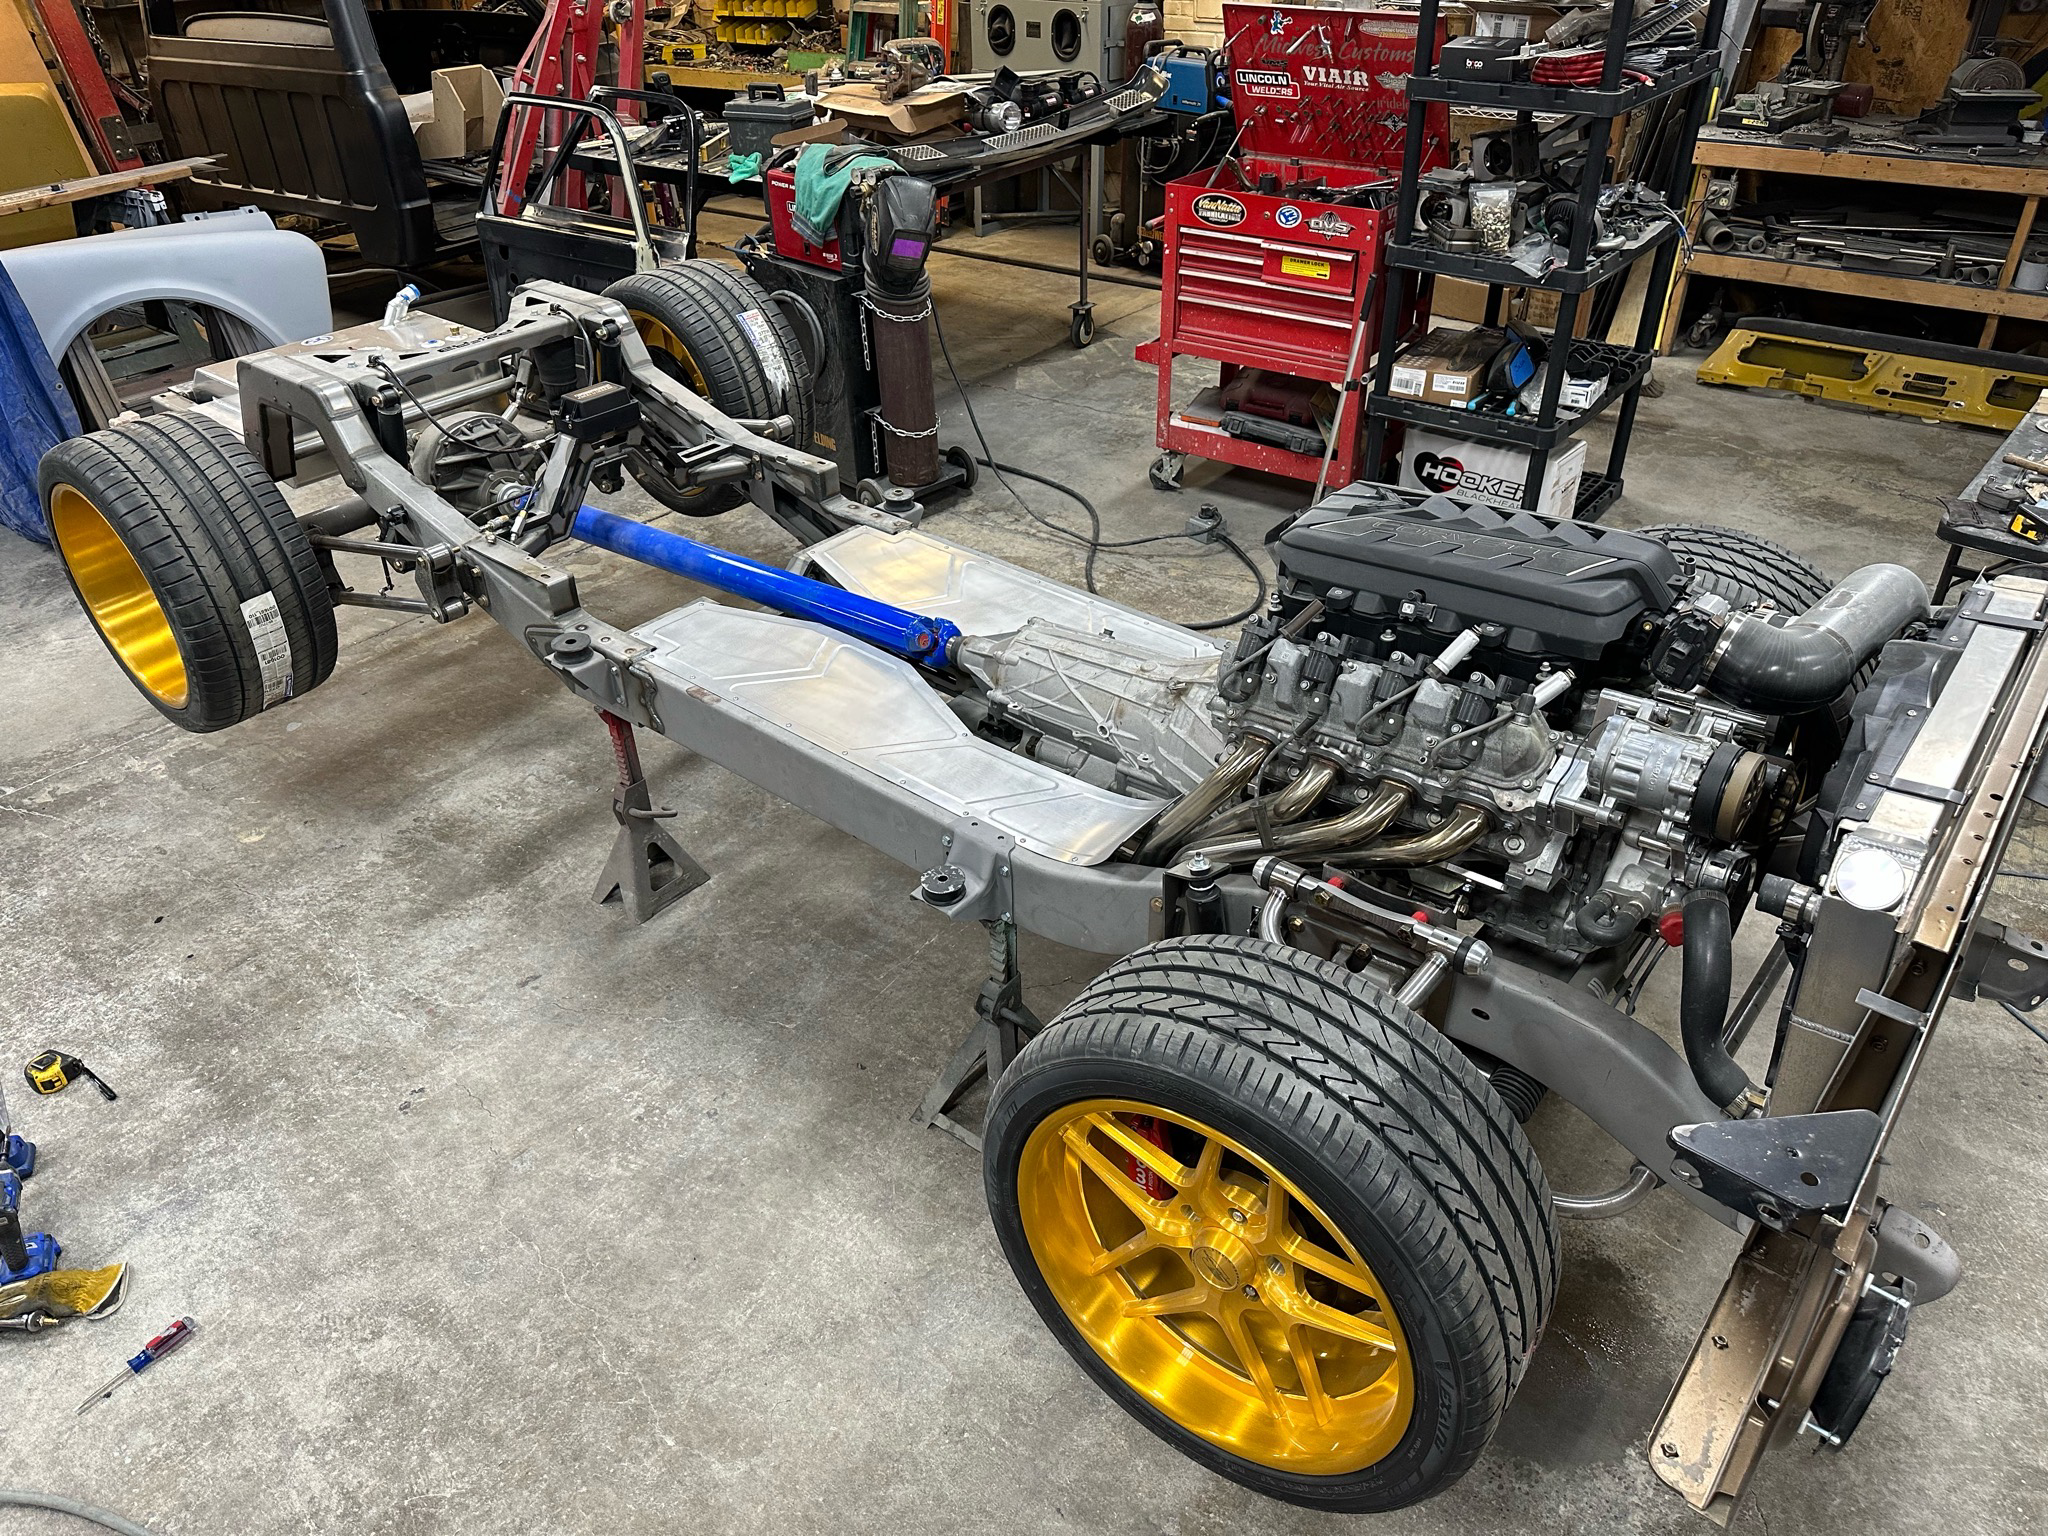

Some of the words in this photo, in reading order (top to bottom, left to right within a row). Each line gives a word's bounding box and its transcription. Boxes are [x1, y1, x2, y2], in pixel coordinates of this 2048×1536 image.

[1338, 39, 1416, 63] Customs
[1240, 72, 1288, 85] LINCOLN
[1302, 65, 1369, 87] VIAIR
[1303, 80, 1319, 88] Your
[1252, 85, 1293, 96] WELDERS
[771, 180, 788, 188] POWER
[1289, 257, 1310, 265] DRAWER
[1457, 488, 1522, 509] BLACKHEA
